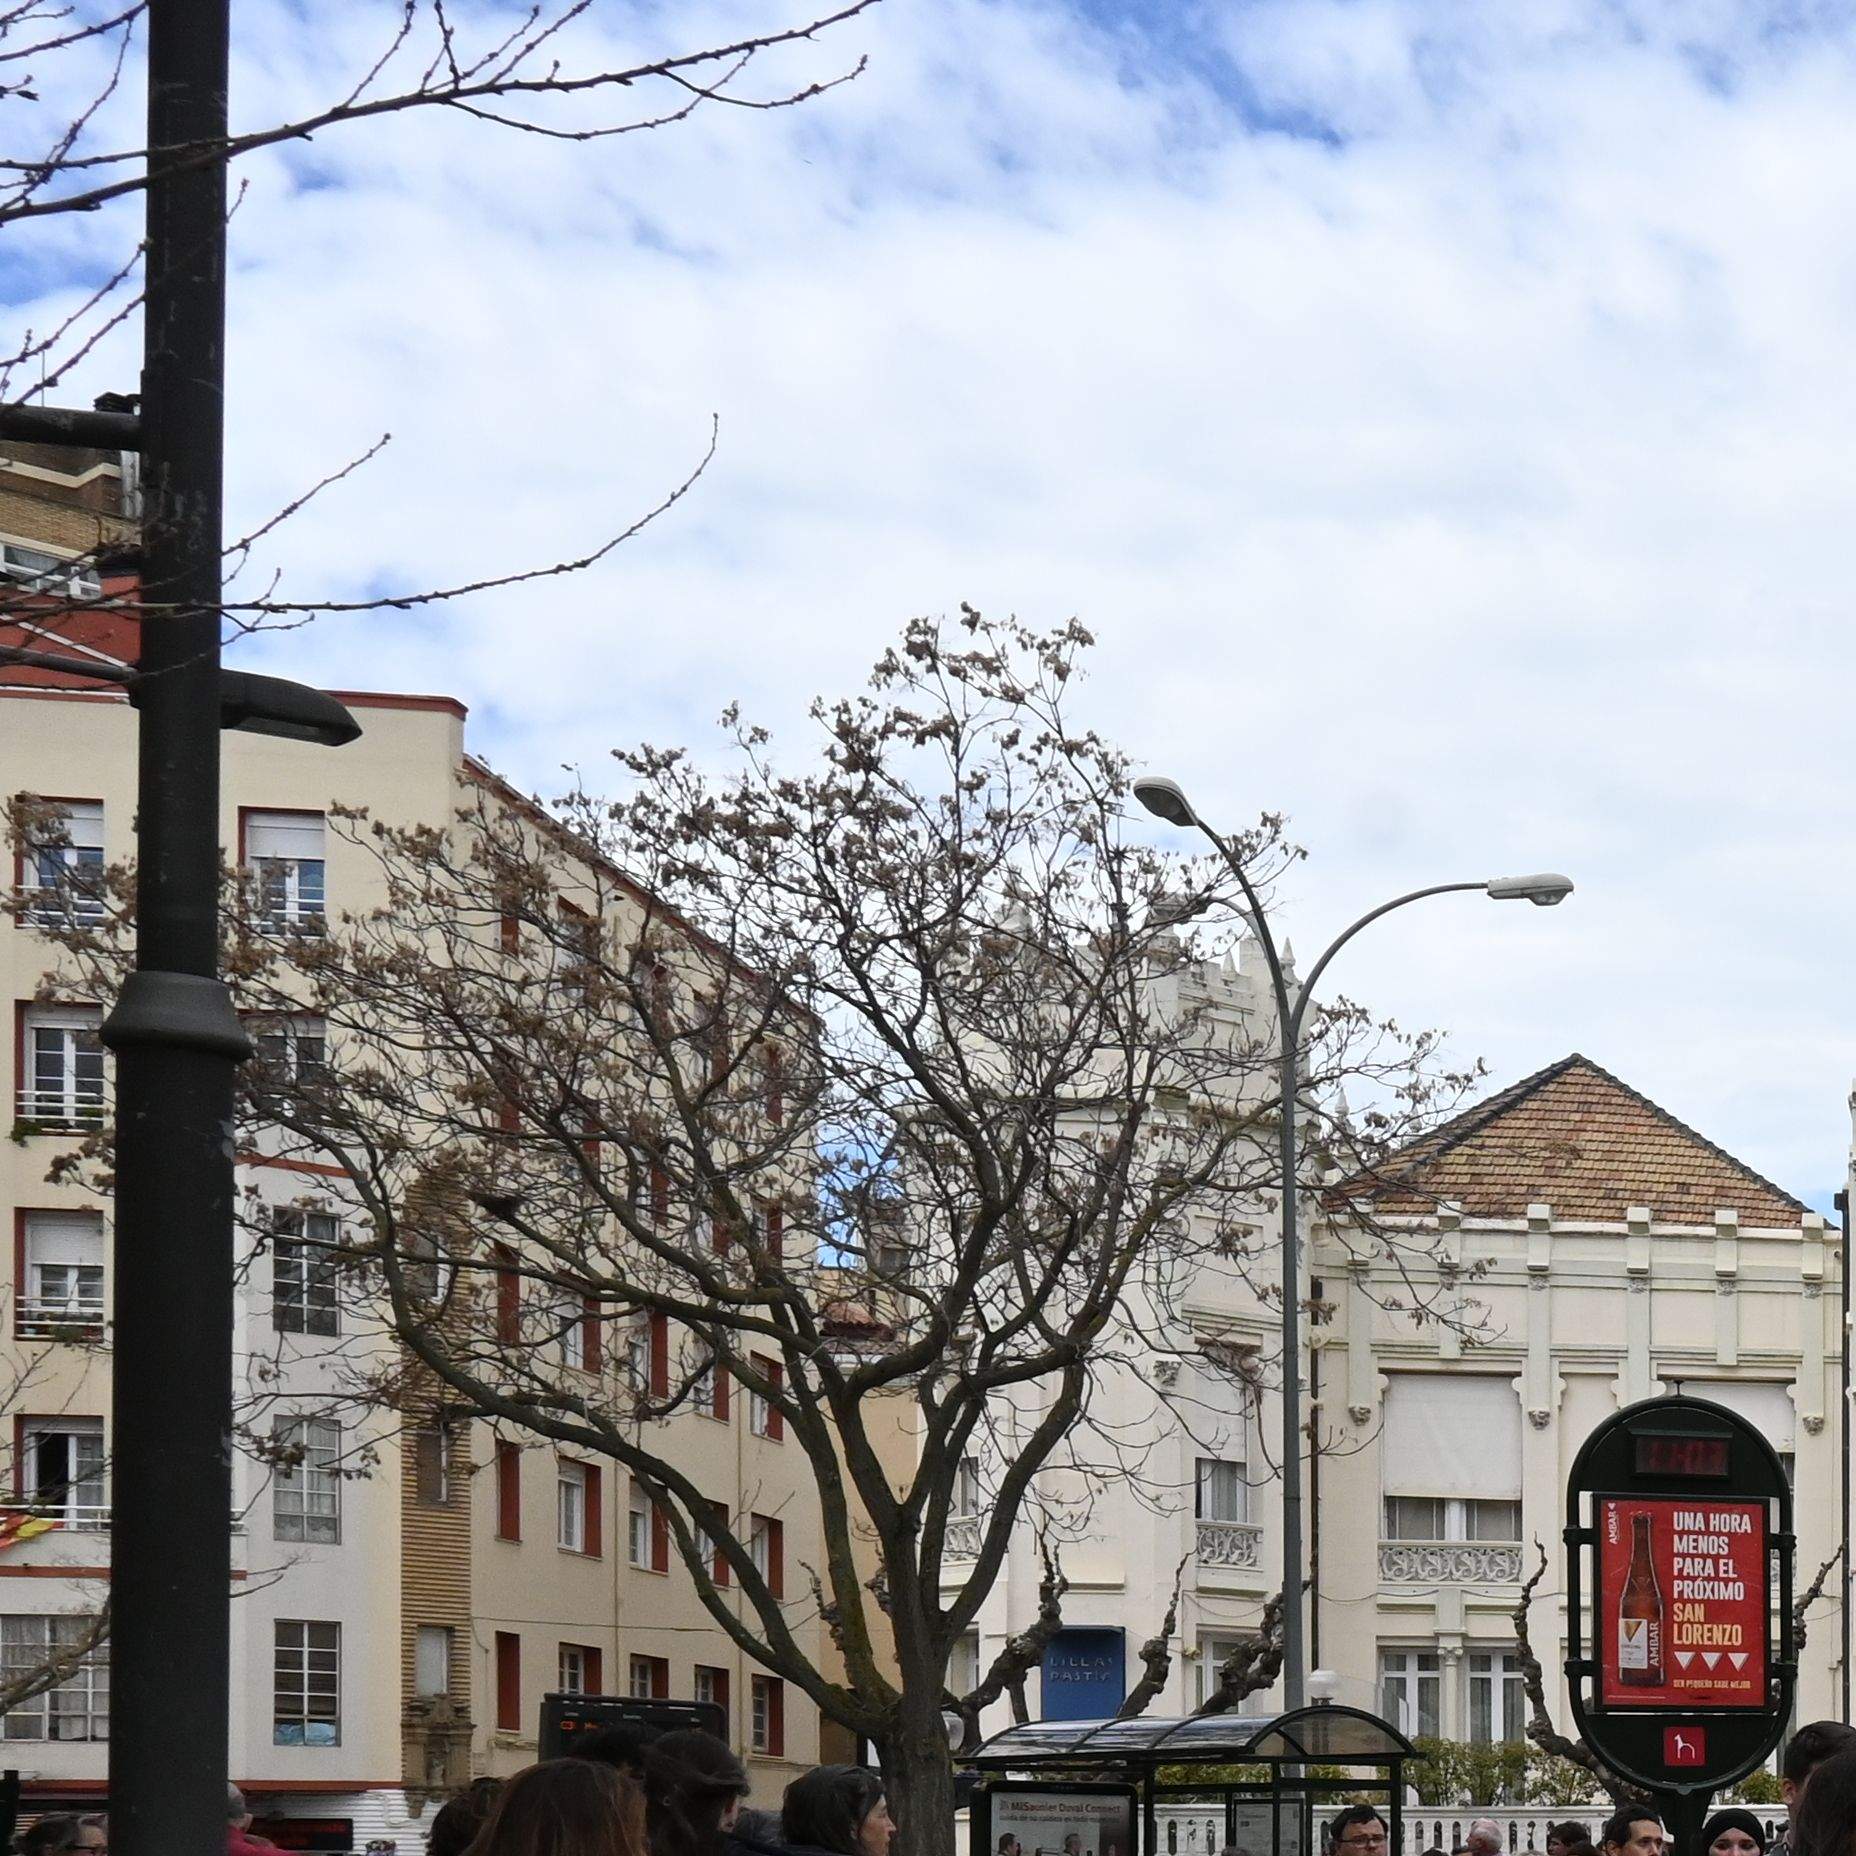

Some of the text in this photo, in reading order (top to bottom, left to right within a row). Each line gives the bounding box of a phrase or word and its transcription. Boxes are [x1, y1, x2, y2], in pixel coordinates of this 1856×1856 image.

[1673, 1511, 1752, 1533] UNA HORA
[1673, 1534, 1729, 1555] MENOS
[1673, 1557, 1738, 1578] PARA EL
[1673, 1577, 1745, 1601] PRÓXIMO
[1673, 1602, 1705, 1622] SAN
[1649, 1621, 1660, 1666] AMBAR
[1673, 1623, 1742, 1646] LORENZO
